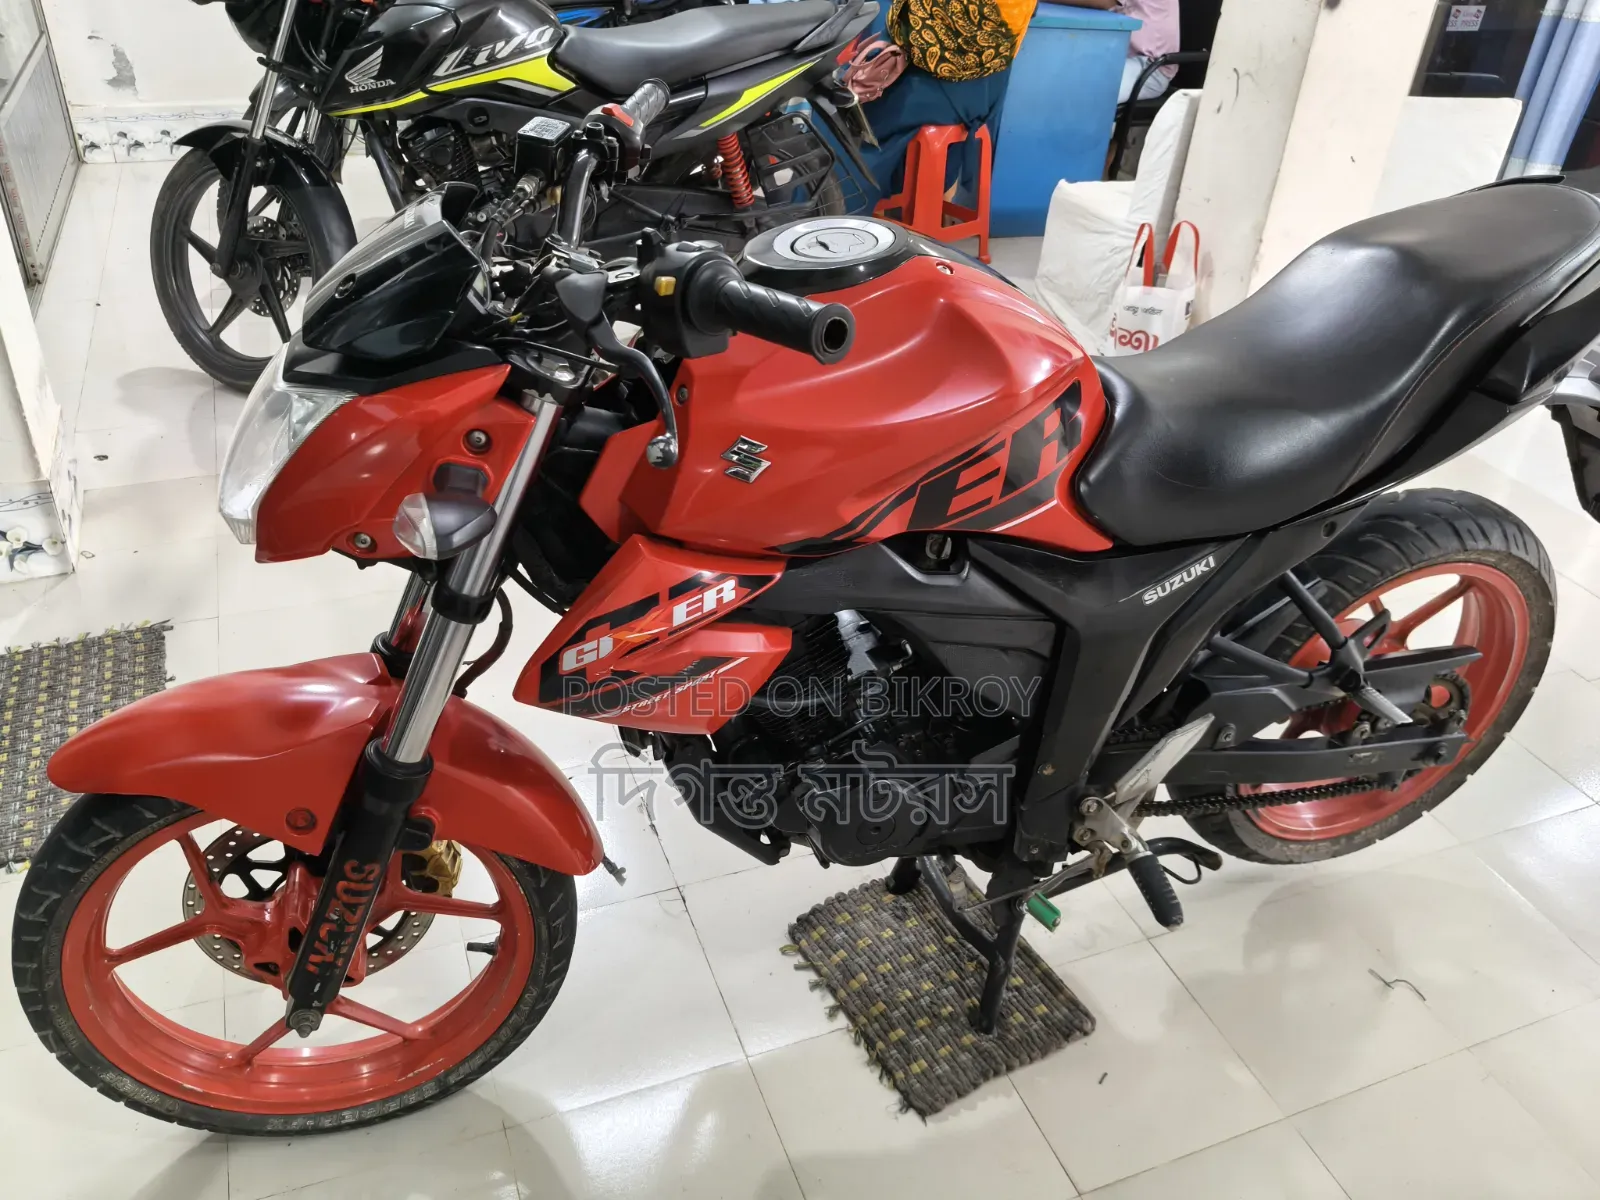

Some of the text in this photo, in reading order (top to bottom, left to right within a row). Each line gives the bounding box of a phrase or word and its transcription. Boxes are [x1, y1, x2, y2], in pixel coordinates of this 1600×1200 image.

[349, 78, 397, 94] HONDA
[1143, 555, 1216, 605] SUZUKI
[621, 669, 718, 713] STREET SPORT
